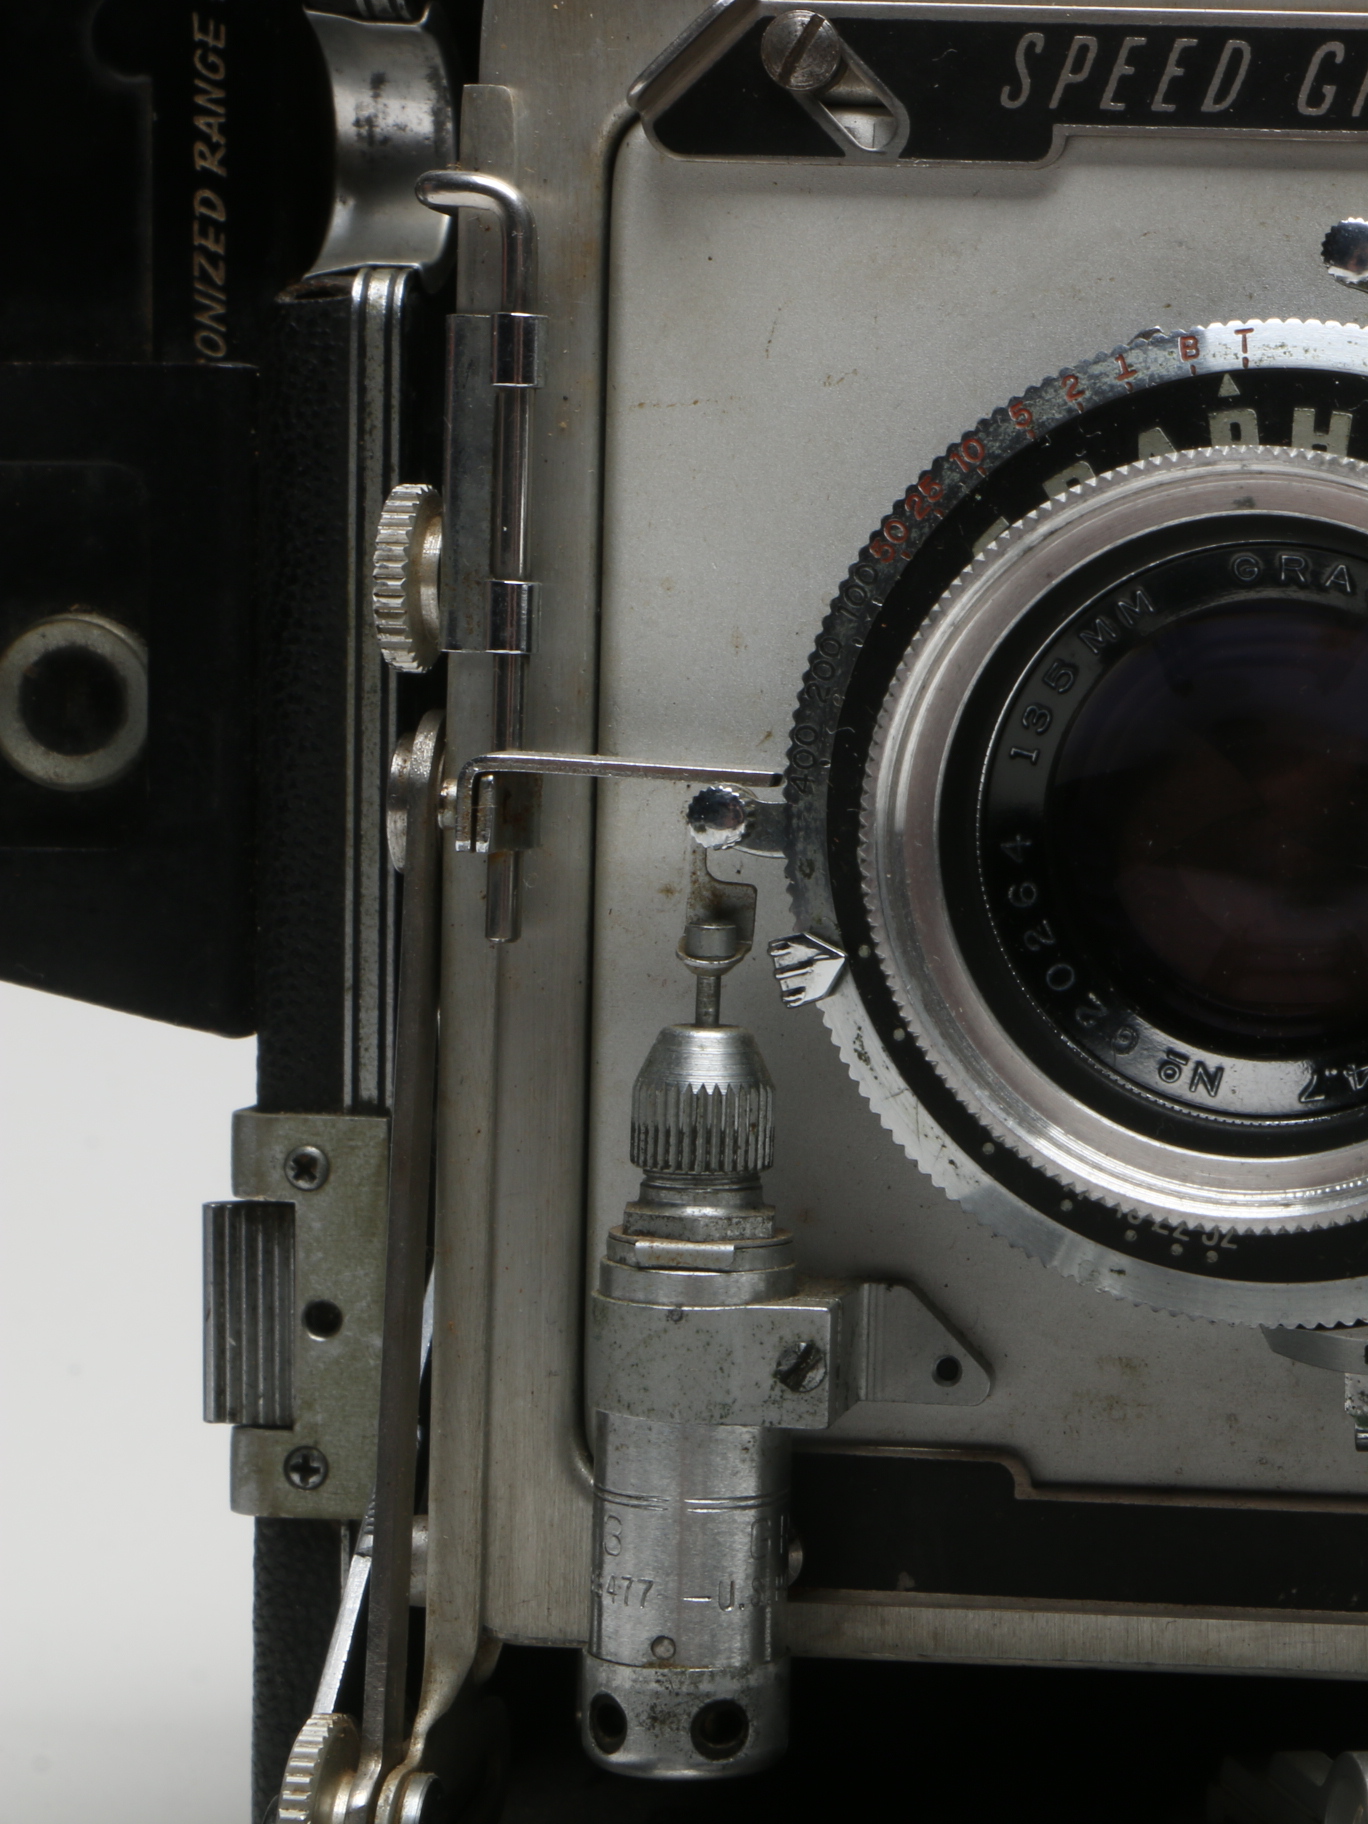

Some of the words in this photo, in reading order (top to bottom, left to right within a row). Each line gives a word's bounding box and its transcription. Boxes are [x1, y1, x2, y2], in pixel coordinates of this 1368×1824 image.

[193, 11, 228, 177] RANGE
[1001, 32, 1252, 114] SPEED
[193, 188, 228, 362] ONIZED
[789, 723, 819, 795] 400
[805, 635, 842, 703] 200
[836, 561, 879, 620] 100
[868, 518, 909, 564] 50
[903, 474, 945, 521] 25
[948, 436, 986, 473] 10
[1008, 401, 1034, 429] 5
[1060, 374, 1086, 401] 2
[1114, 353, 1138, 382] 1
[1177, 335, 1200, 363] B
[1233, 327, 1255, 354] T
